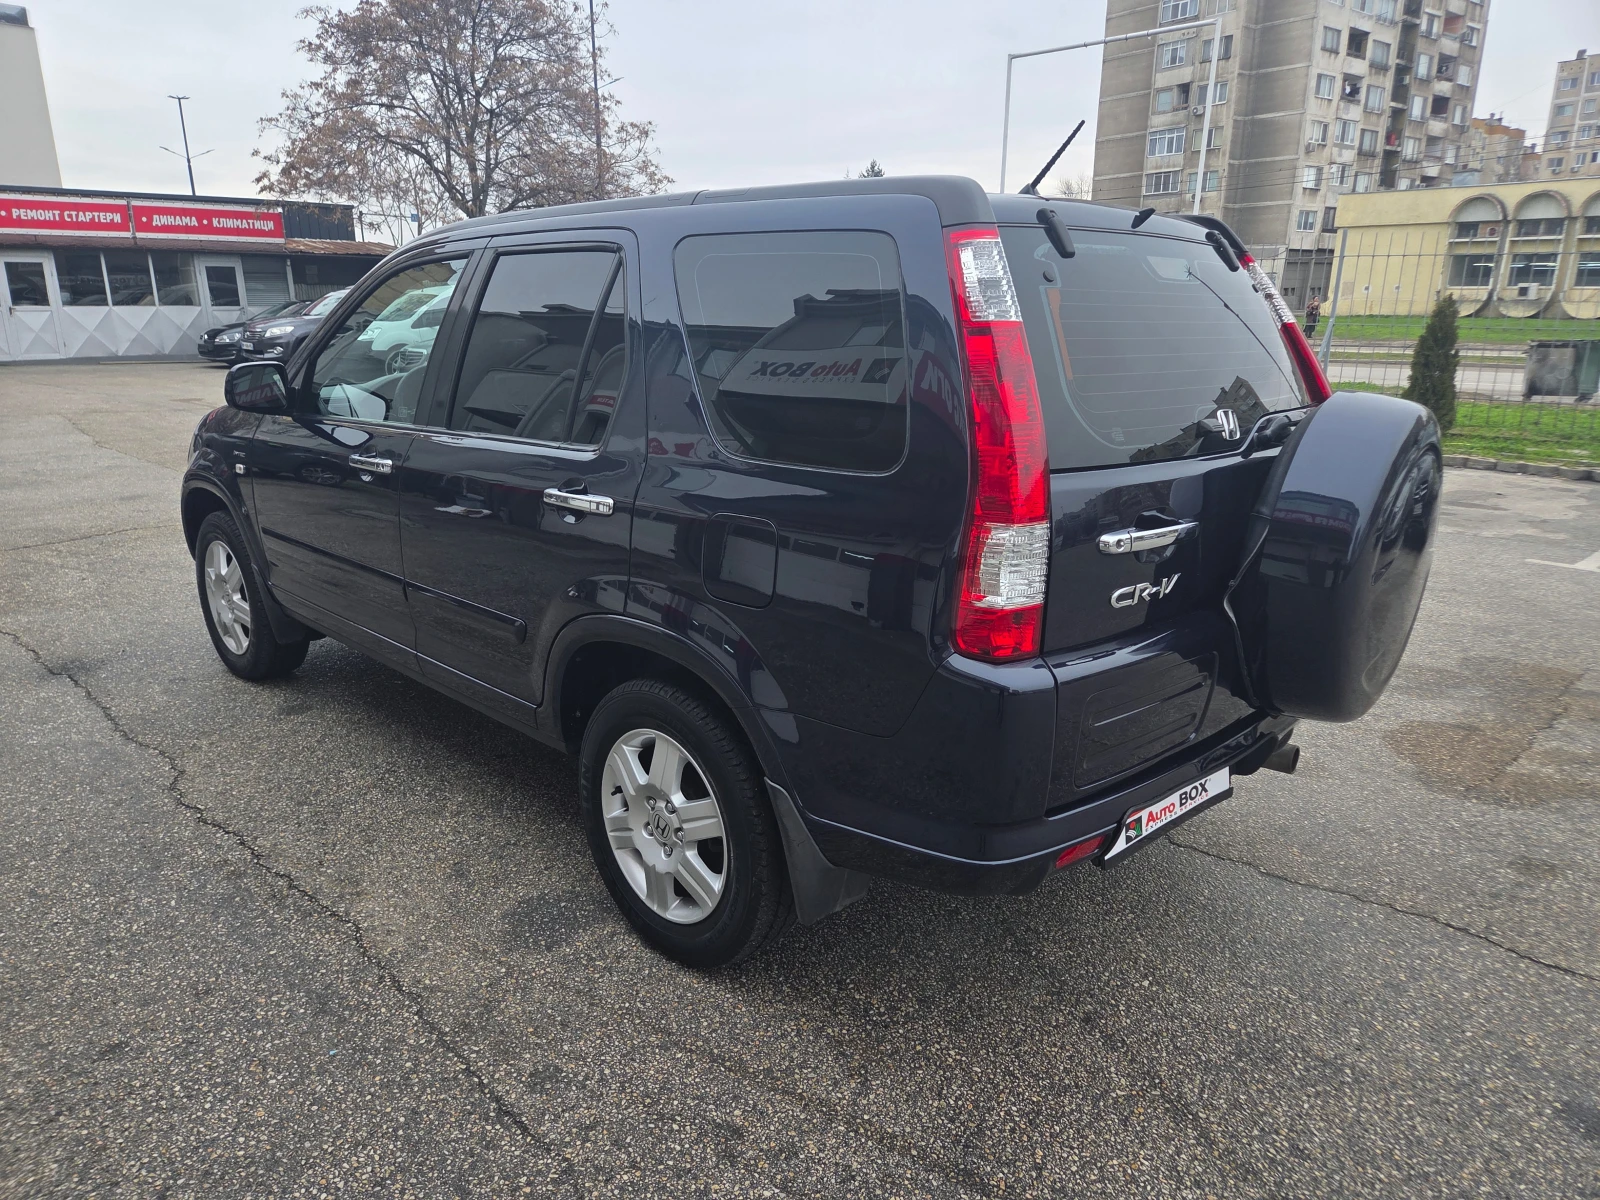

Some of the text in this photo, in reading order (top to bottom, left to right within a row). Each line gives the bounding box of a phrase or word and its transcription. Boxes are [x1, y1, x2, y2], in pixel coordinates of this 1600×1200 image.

[12, 208, 121, 223] РЕМОНТ СТАРТЕРИ
[152, 214, 274, 231] ДИНАМА КЛИМАТИЦИ
[1111, 573, 1181, 609] CR-V
[1179, 779, 1209, 808] BOX
